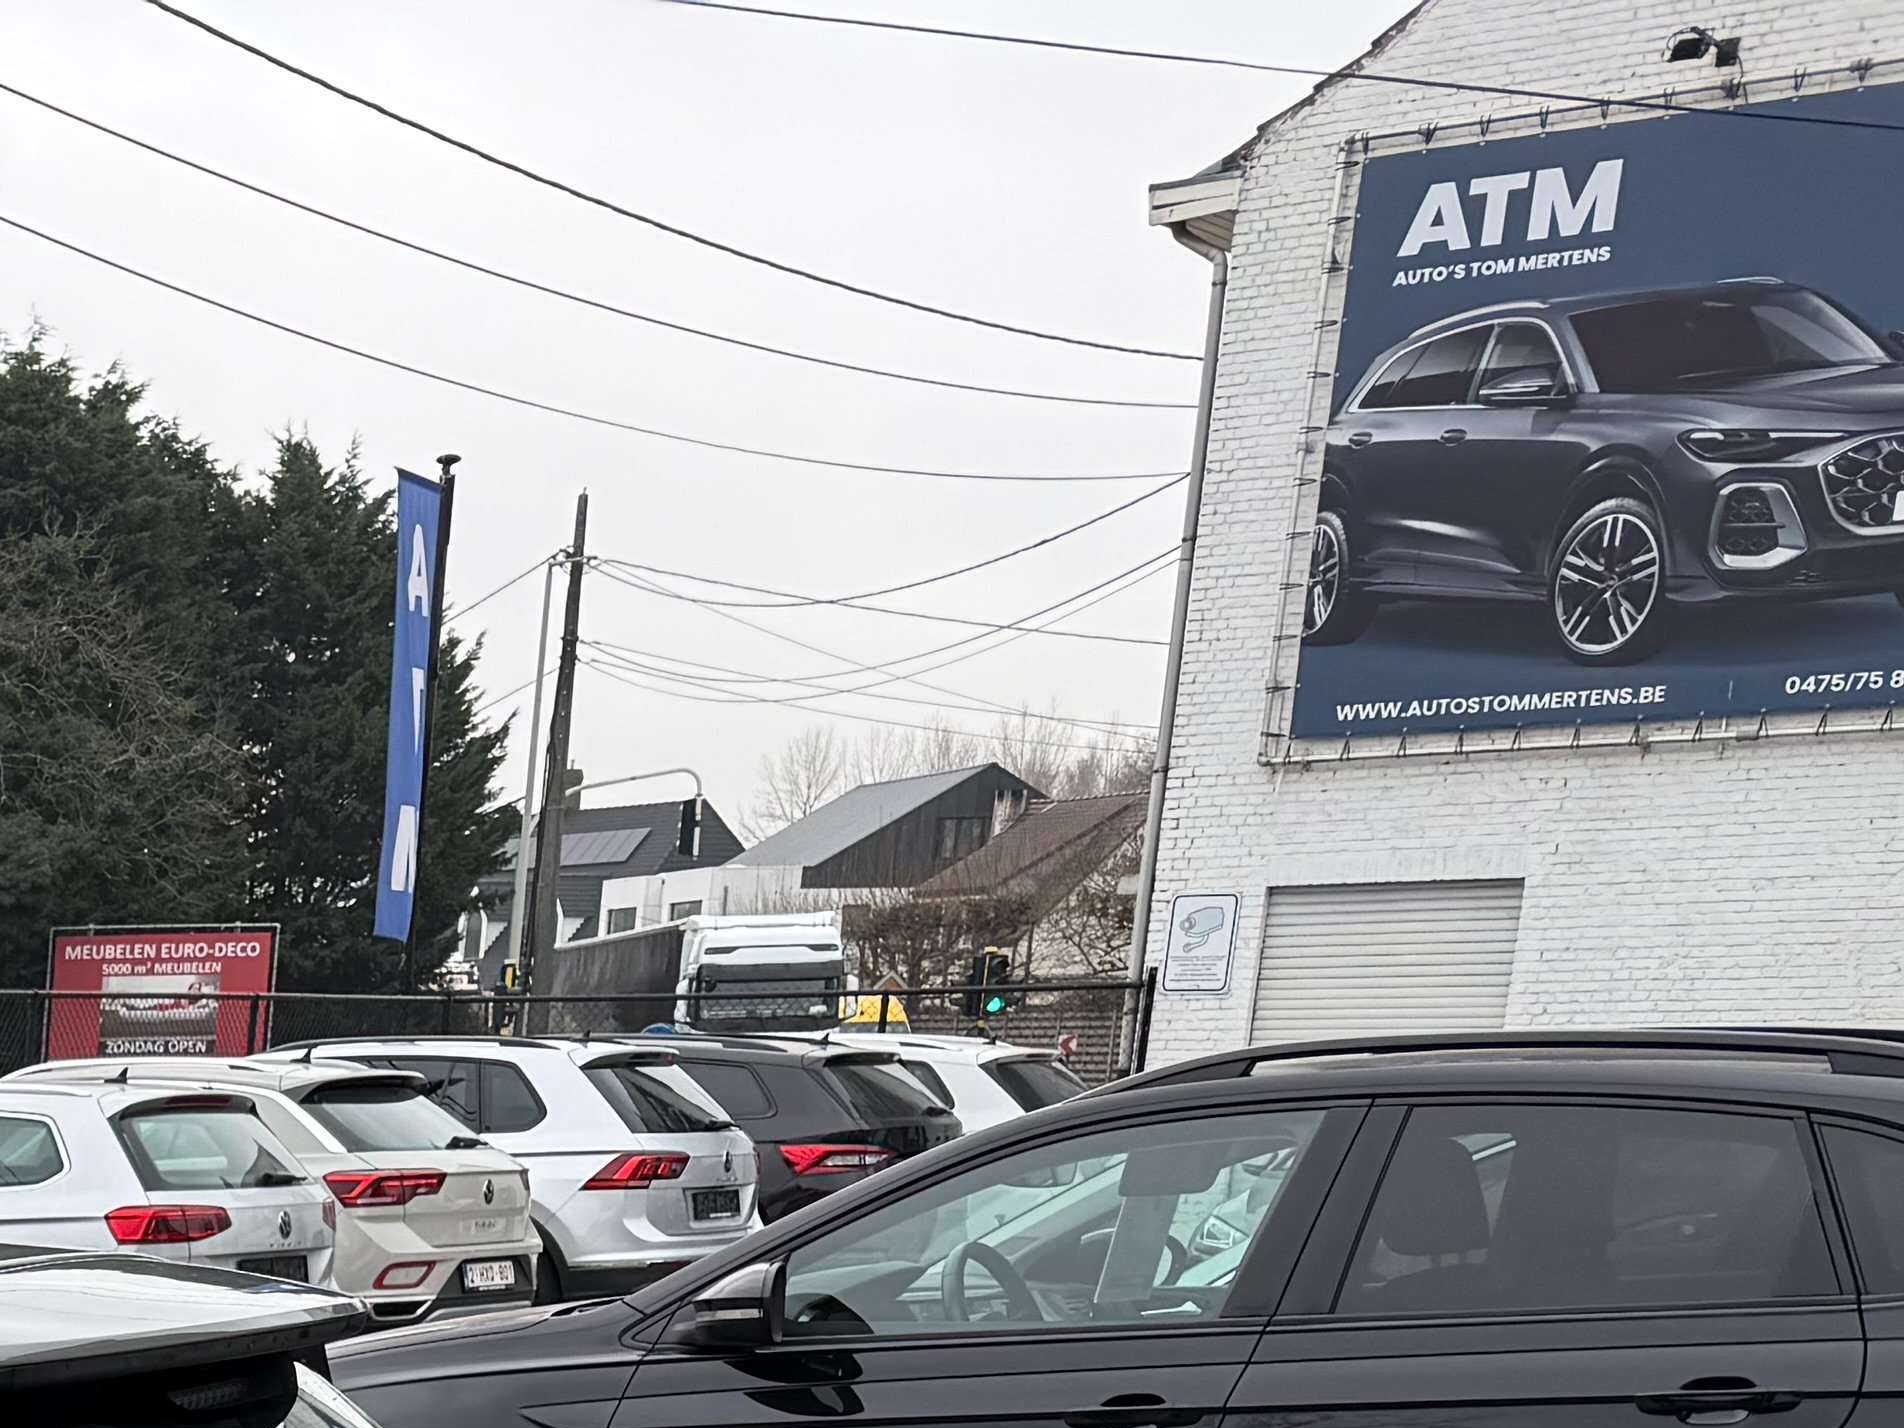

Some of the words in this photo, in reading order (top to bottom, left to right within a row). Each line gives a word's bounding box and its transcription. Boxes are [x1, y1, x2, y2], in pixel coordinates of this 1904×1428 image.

[1396, 158, 1624, 257] ATM
[1392, 262, 1466, 287] AUTO'S
[1471, 257, 1515, 277] TOM
[1517, 246, 1611, 272] MERTENS
[1784, 671, 1884, 695] 0475/75
[1335, 684, 1667, 722] WWW.AUTOSTOMMERTENS.BE
[64, 943, 157, 960] MEUBELEN
[161, 941, 261, 959] EURO-DECO
[102, 963, 132, 975] 5000
[154, 962, 222, 974] MEUBELEN
[105, 1040, 165, 1054] ZONDAG
[168, 1040, 207, 1053] OPEN
